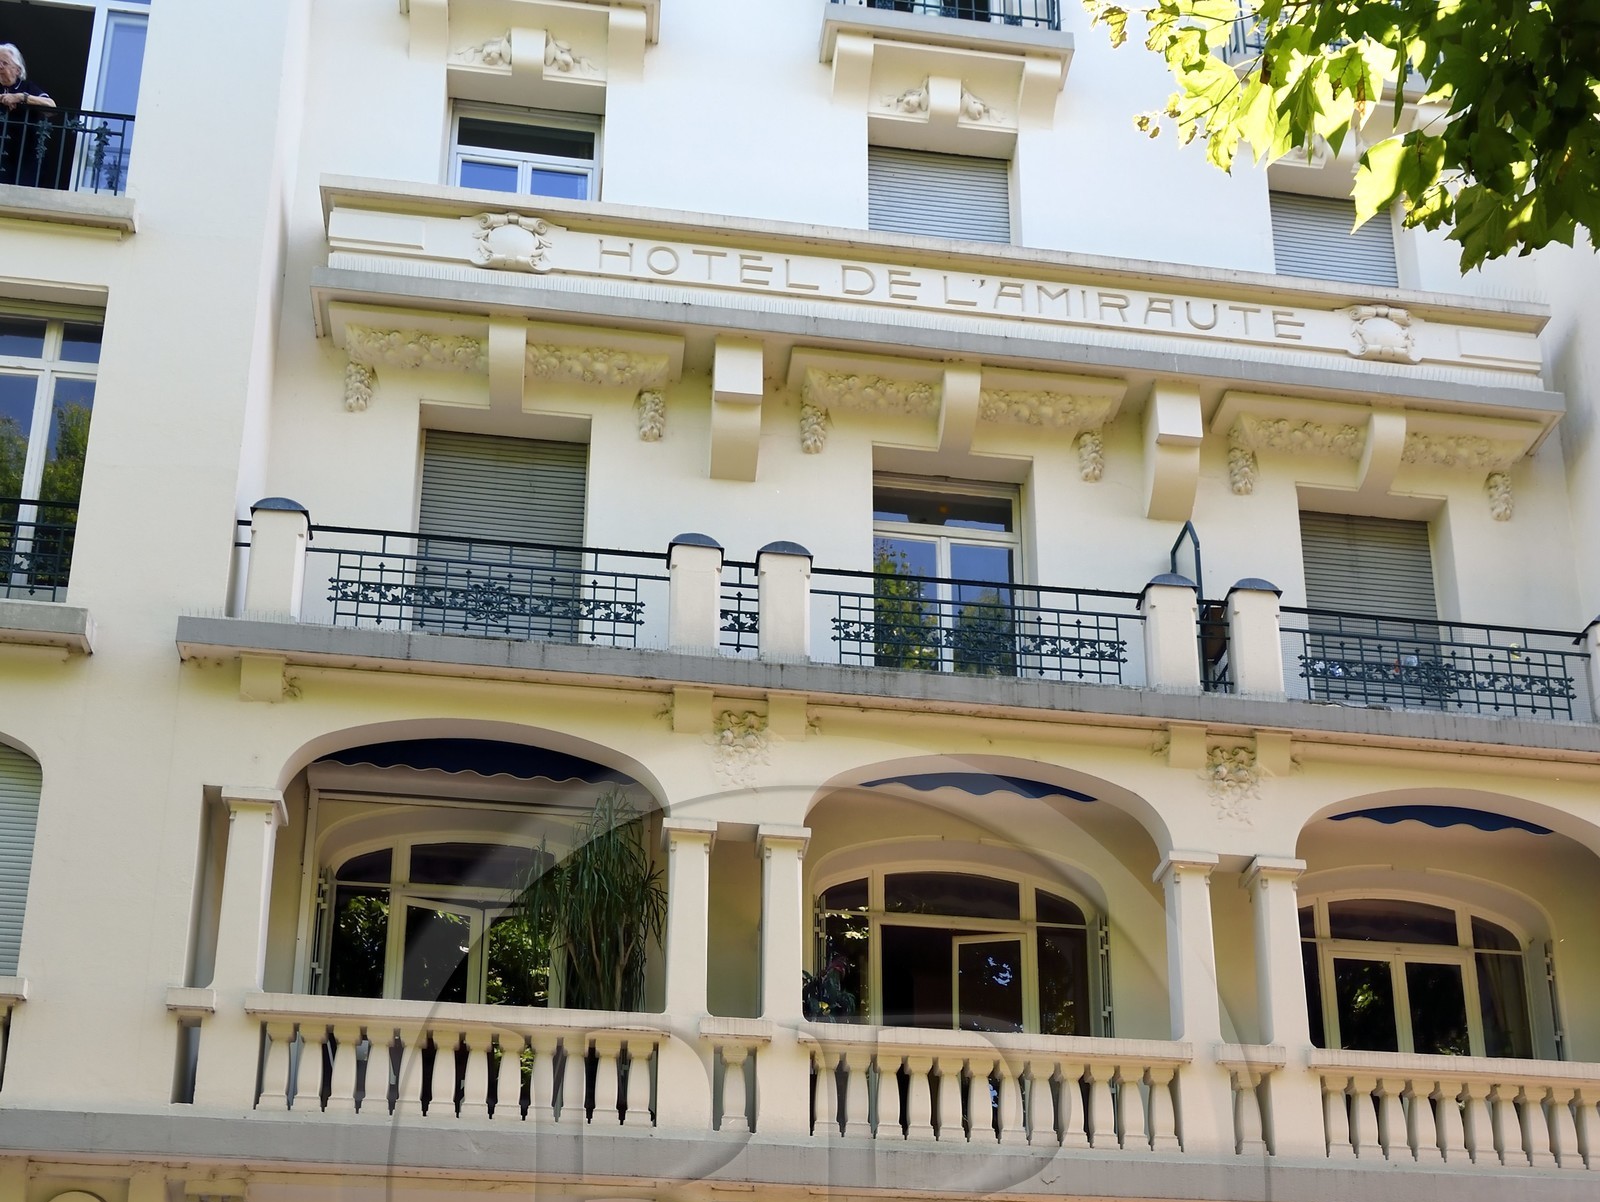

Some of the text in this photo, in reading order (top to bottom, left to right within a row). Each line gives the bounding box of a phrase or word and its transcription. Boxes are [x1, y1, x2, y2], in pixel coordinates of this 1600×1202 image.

[599, 239, 1305, 340] HOTEL DE L'AMIRAUTE
